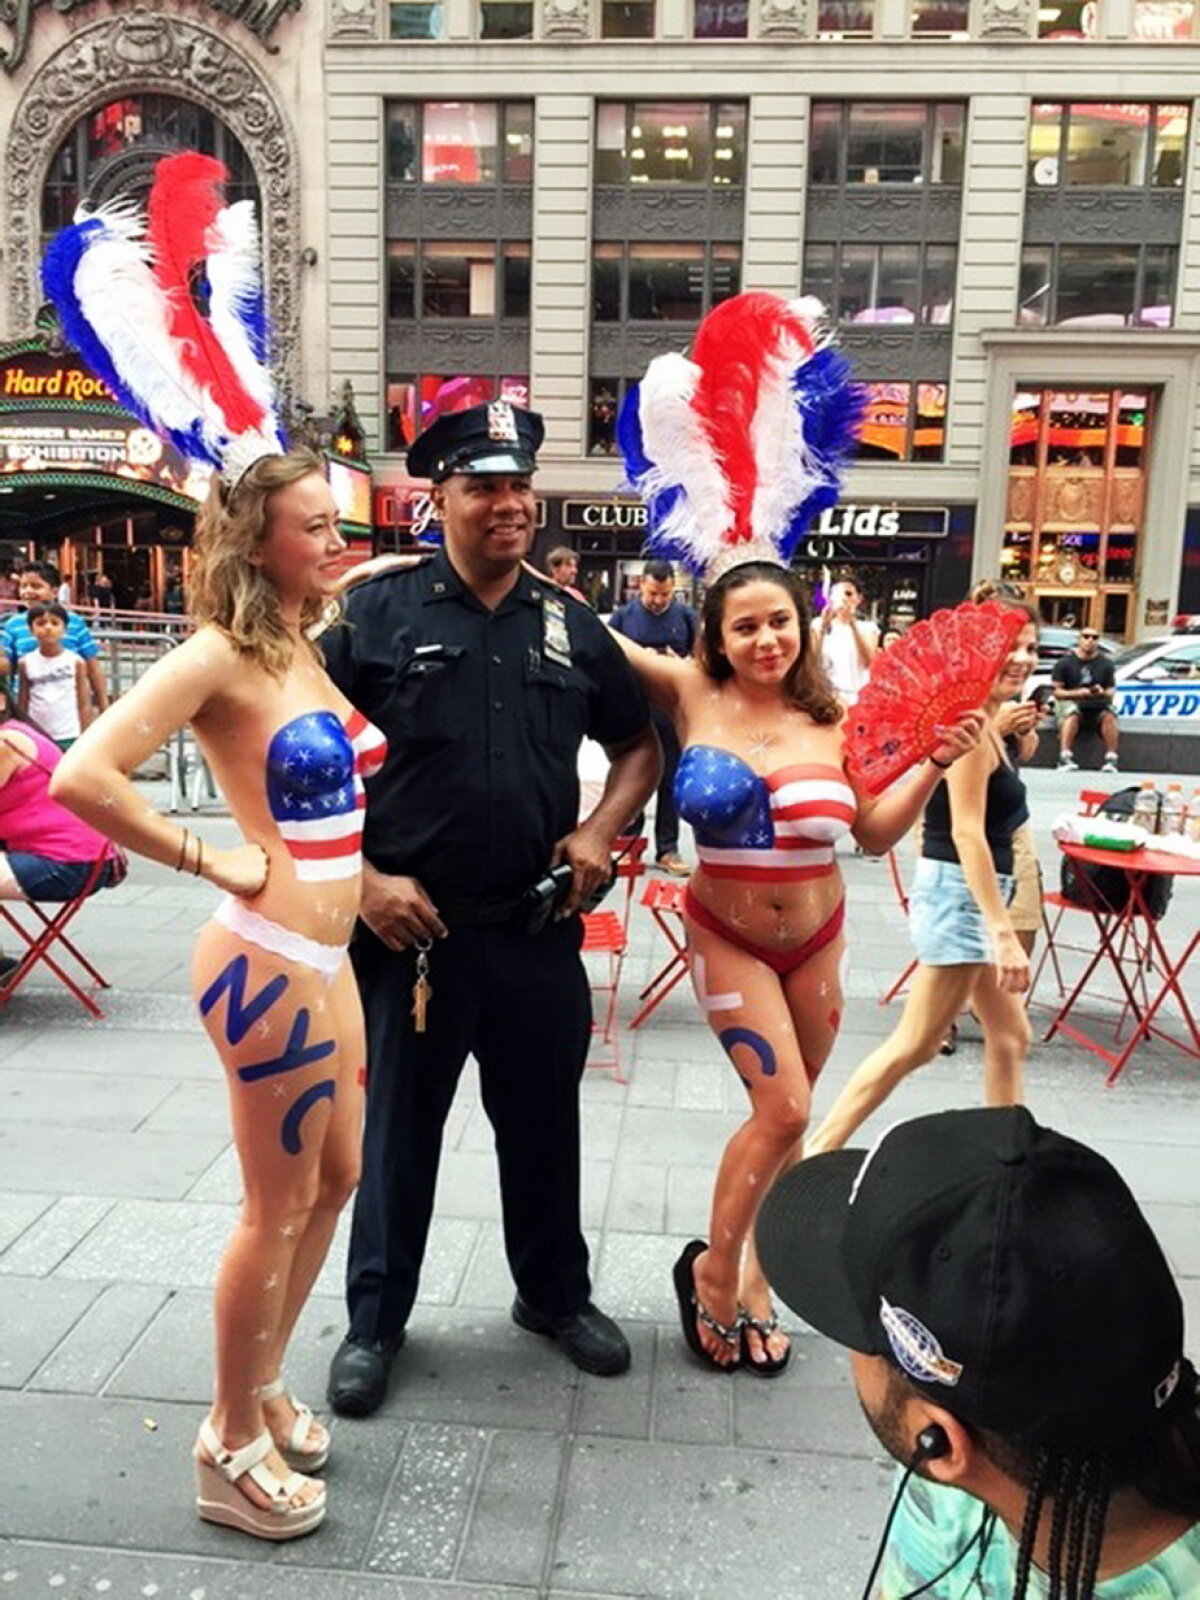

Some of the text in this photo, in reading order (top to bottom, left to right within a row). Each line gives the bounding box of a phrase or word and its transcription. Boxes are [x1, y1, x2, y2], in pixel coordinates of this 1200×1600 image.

[4, 369, 119, 401] Hard Roc
[7, 446, 127, 461] EXHIBITION
[583, 506, 648, 527] CLUB
[820, 505, 900, 536] Lids
[1118, 694, 1200, 716] NYPD
[200, 954, 336, 1156] NYC
